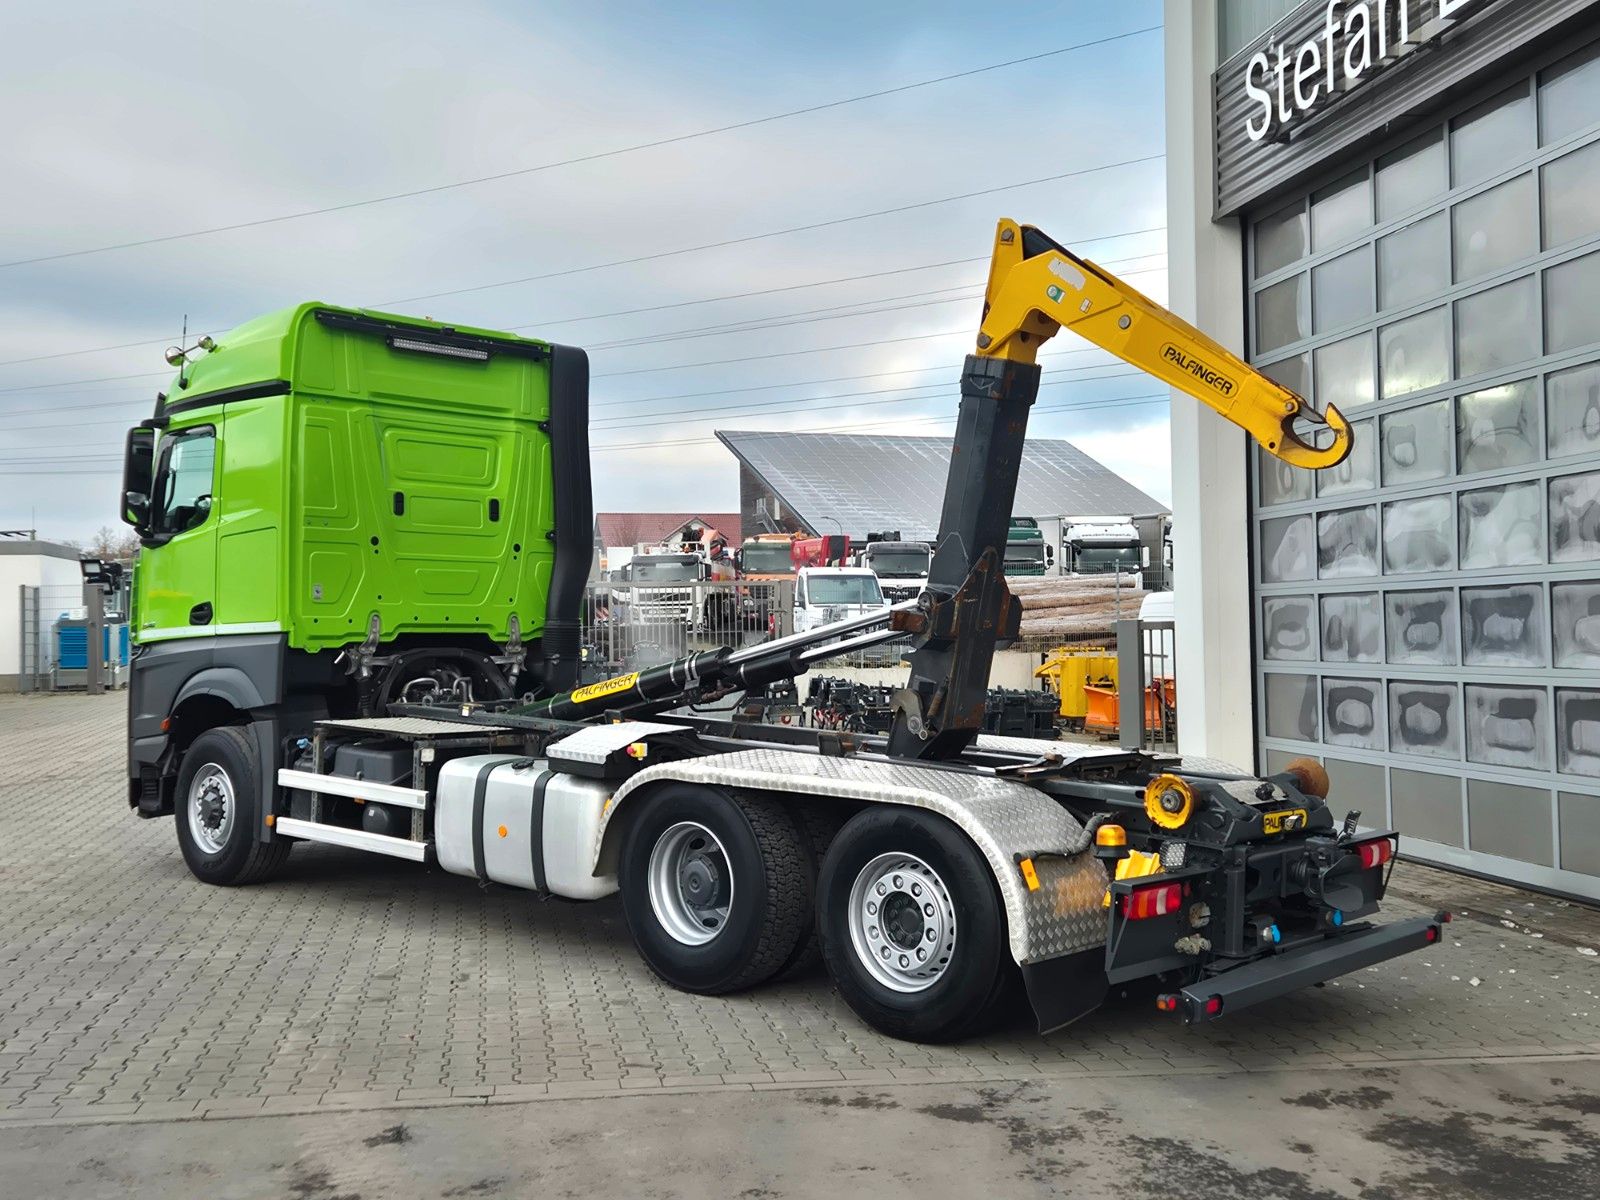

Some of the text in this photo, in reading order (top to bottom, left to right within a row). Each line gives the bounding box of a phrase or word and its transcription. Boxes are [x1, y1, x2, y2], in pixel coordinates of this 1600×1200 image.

[1245, 0, 1409, 141] Stefan
[1163, 346, 1233, 395] PALFINGER
[575, 674, 634, 698] PALFINGER
